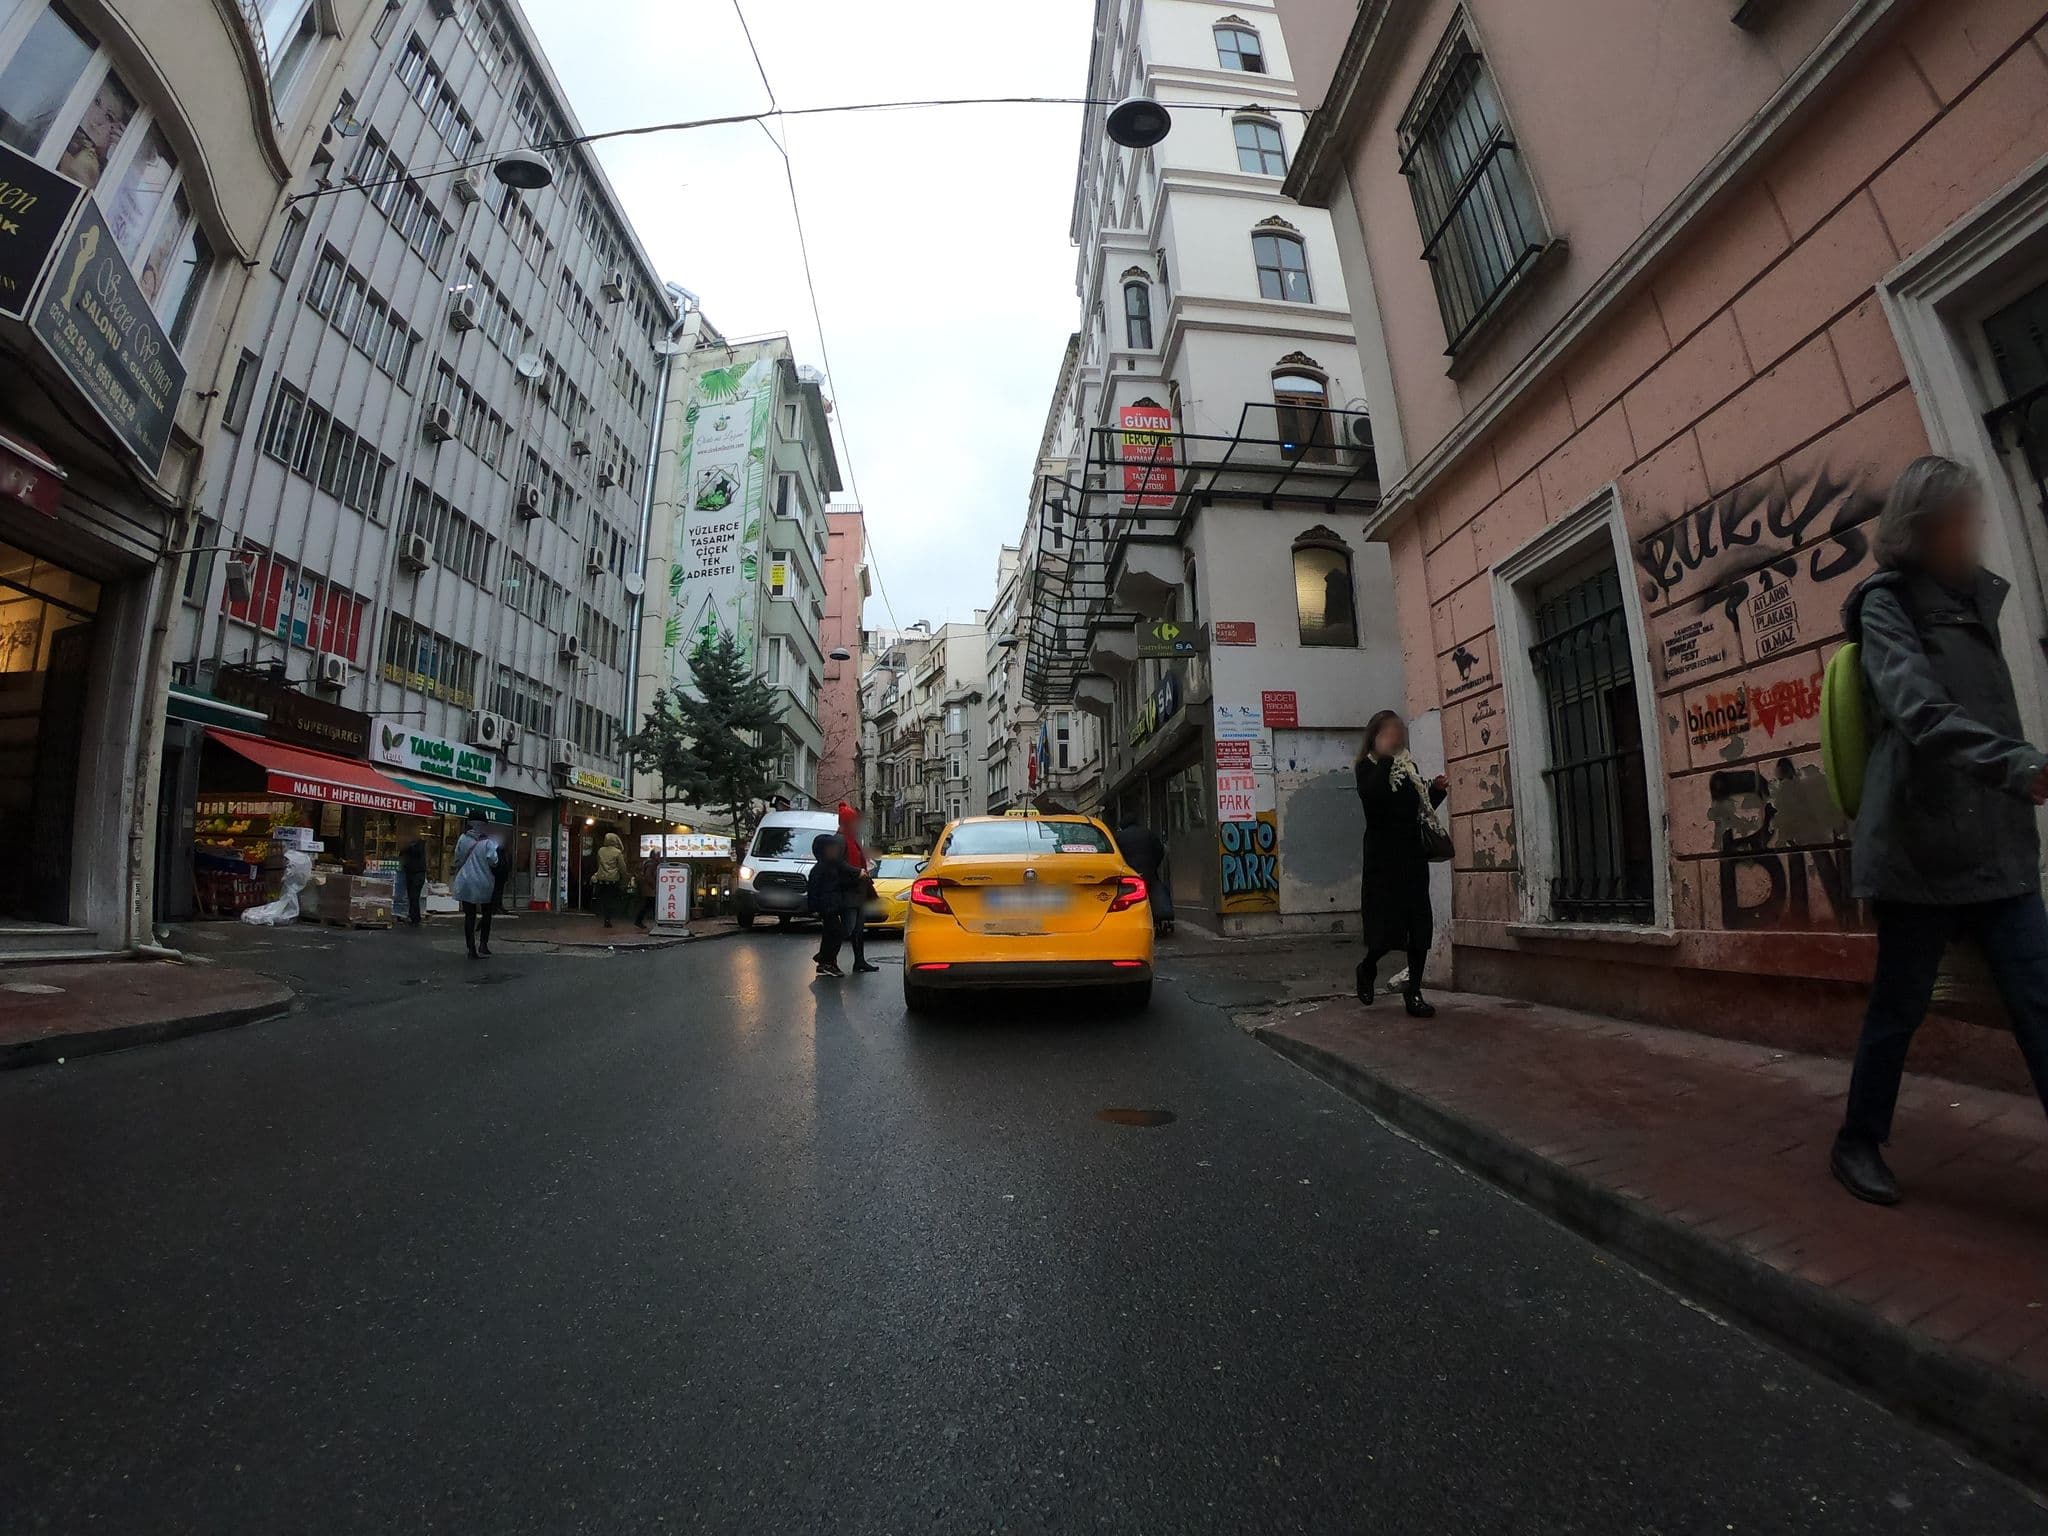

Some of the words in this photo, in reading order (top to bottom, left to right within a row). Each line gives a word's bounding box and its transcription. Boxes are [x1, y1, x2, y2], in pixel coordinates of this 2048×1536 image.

[82, 290, 122, 350] SALONU
[1125, 413, 1169, 429] GÜVEN
[689, 522, 740, 536] YÜZLERCE
[691, 534, 735, 547] TASARIM
[696, 545, 728, 558] ÇİÇEK
[702, 557, 720, 567] TEK
[1753, 584, 1790, 612] ATLARIN
[1756, 605, 1793, 630] PLAKASI
[1761, 627, 1796, 653] OLMAZ
[457, 750, 493, 774] AKTAR
[294, 782, 326, 798] NAMLI
[332, 787, 416, 812] HİPERMARKETLERİ
[1219, 795, 1252, 810] PARK
[1221, 822, 1274, 852] OTO
[1222, 854, 1278, 893] PARK
[667, 885, 676, 919] PARK
